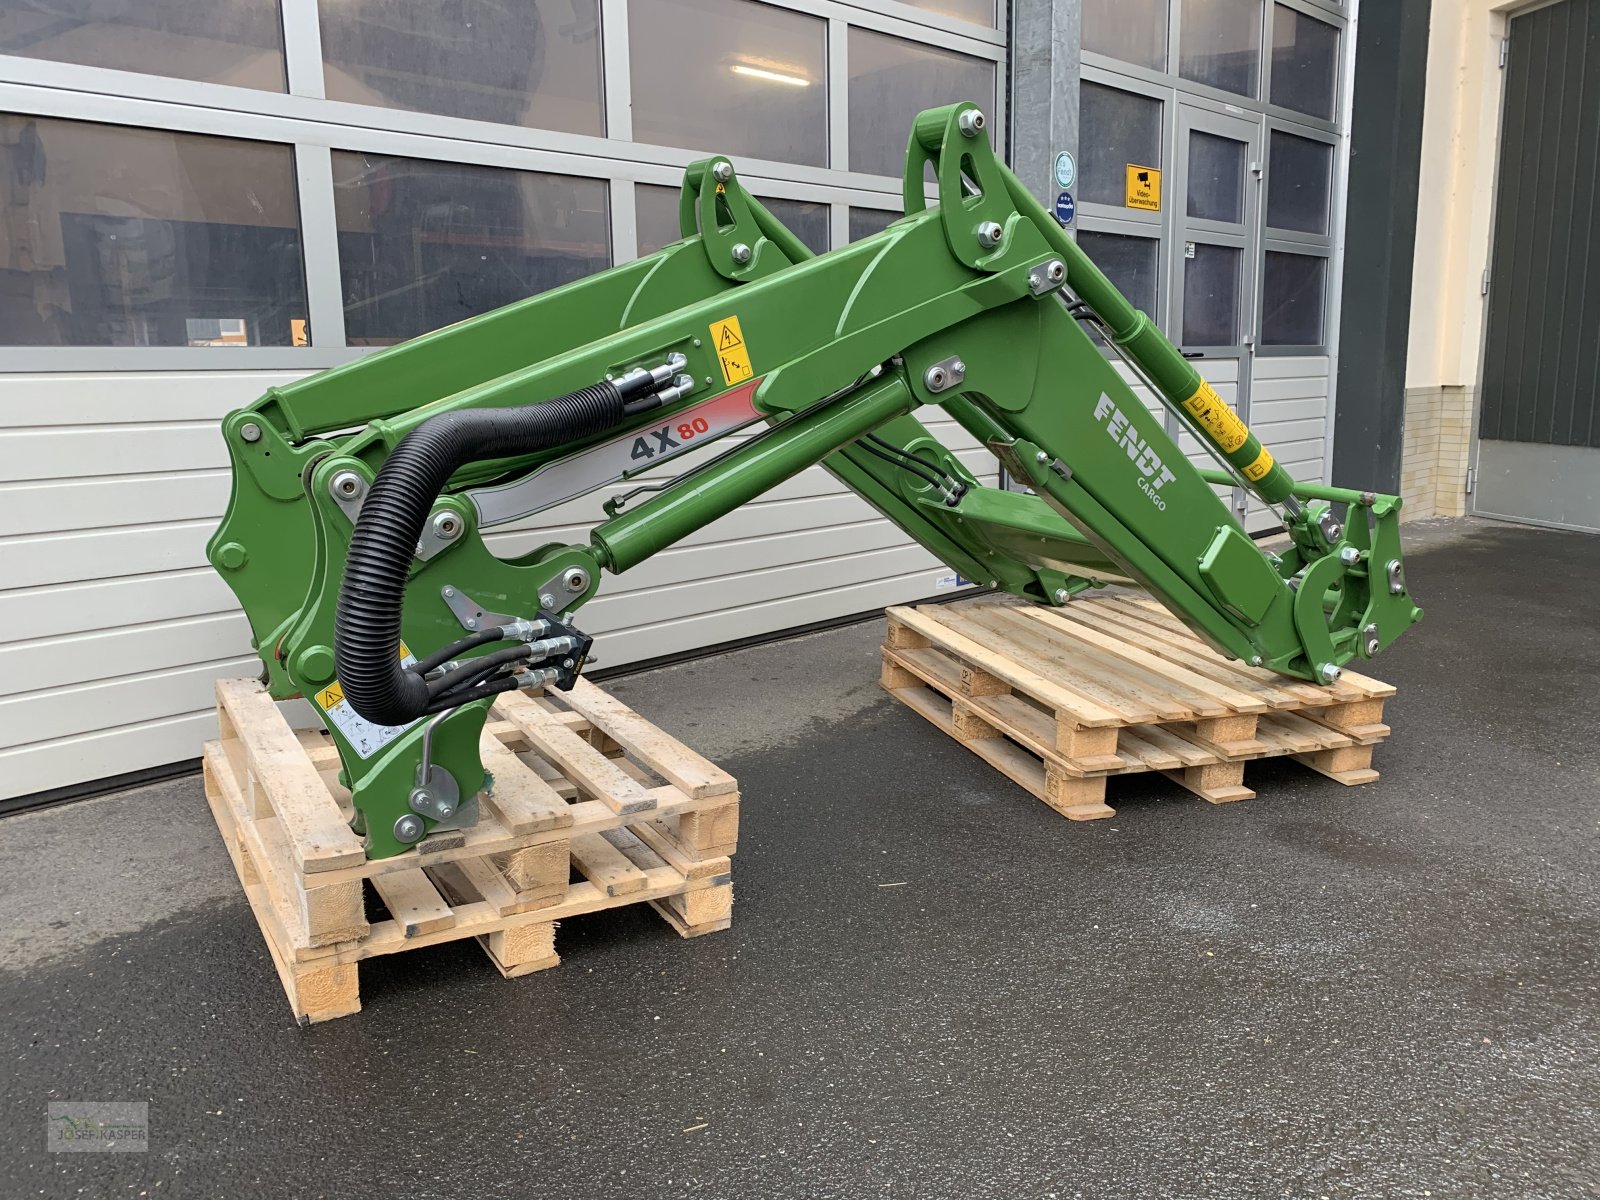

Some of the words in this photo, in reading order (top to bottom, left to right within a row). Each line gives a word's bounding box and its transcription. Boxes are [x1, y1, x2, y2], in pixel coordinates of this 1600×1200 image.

[1137, 190, 1150, 198] Video-
[1094, 391, 1177, 490] FENDT
[1137, 477, 1166, 511] CARGO
